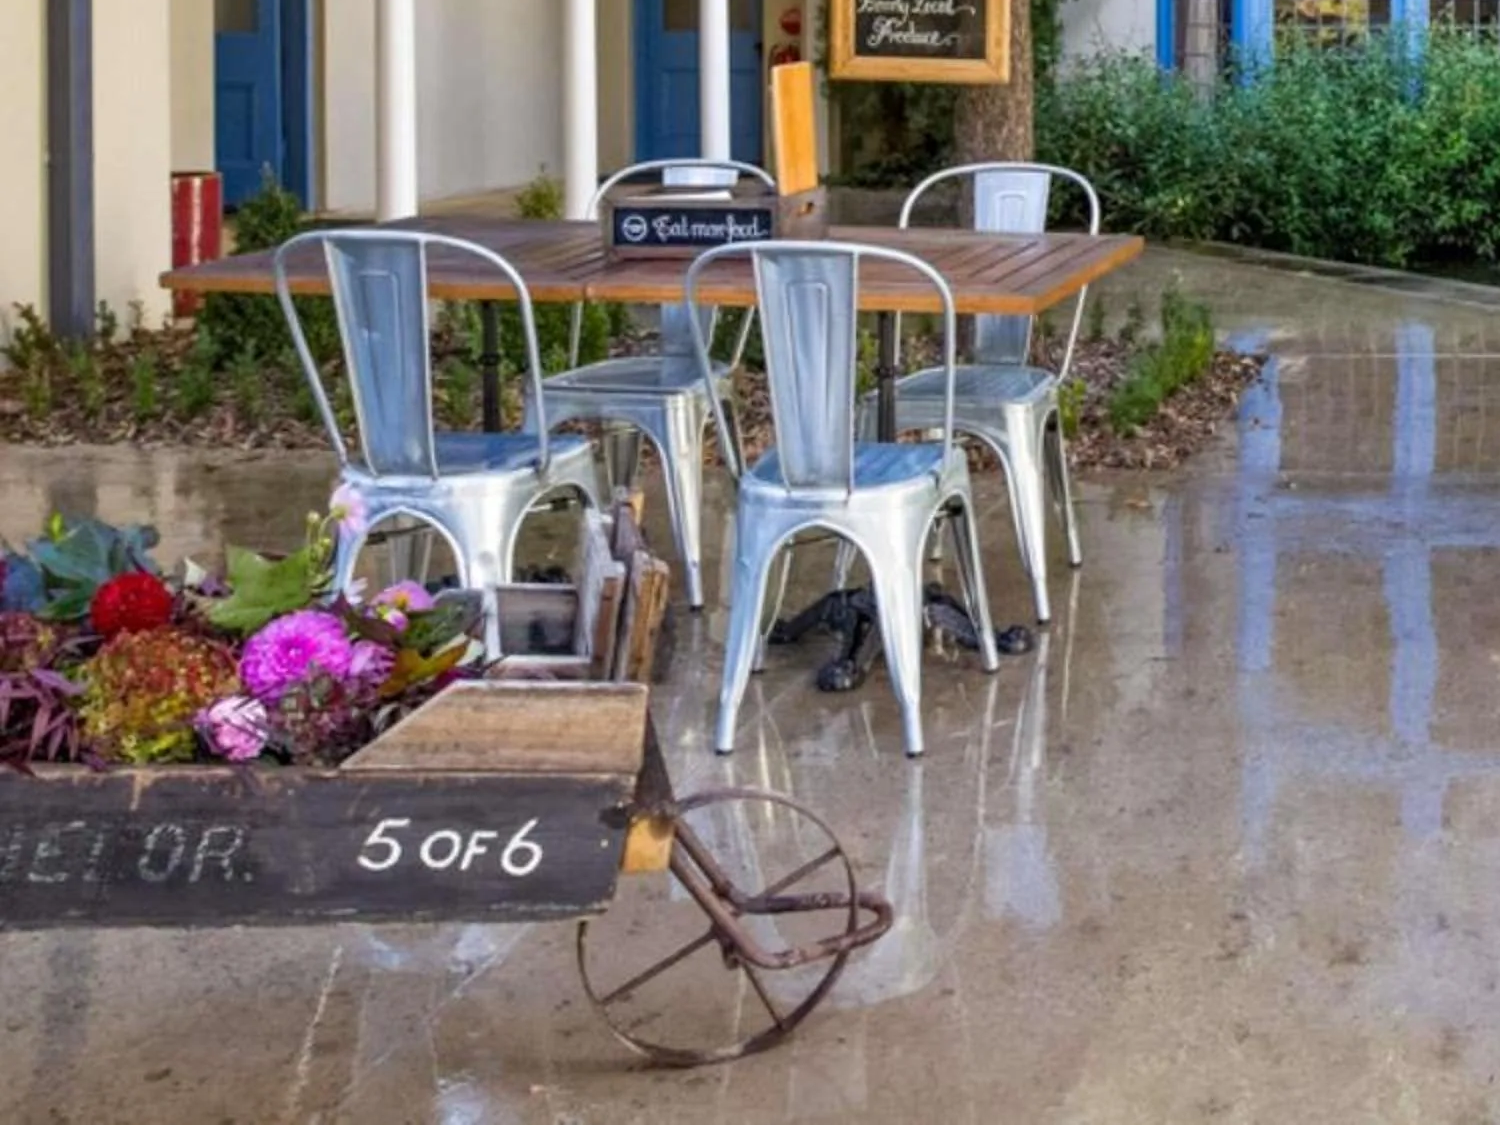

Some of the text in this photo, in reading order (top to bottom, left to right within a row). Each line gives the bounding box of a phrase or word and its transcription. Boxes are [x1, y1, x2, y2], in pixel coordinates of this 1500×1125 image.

[867, 15, 957, 48] Produce
[652, 214, 689, 242] Eat
[691, 221, 725, 238] more
[357, 817, 543, 877] 5 OF 6
